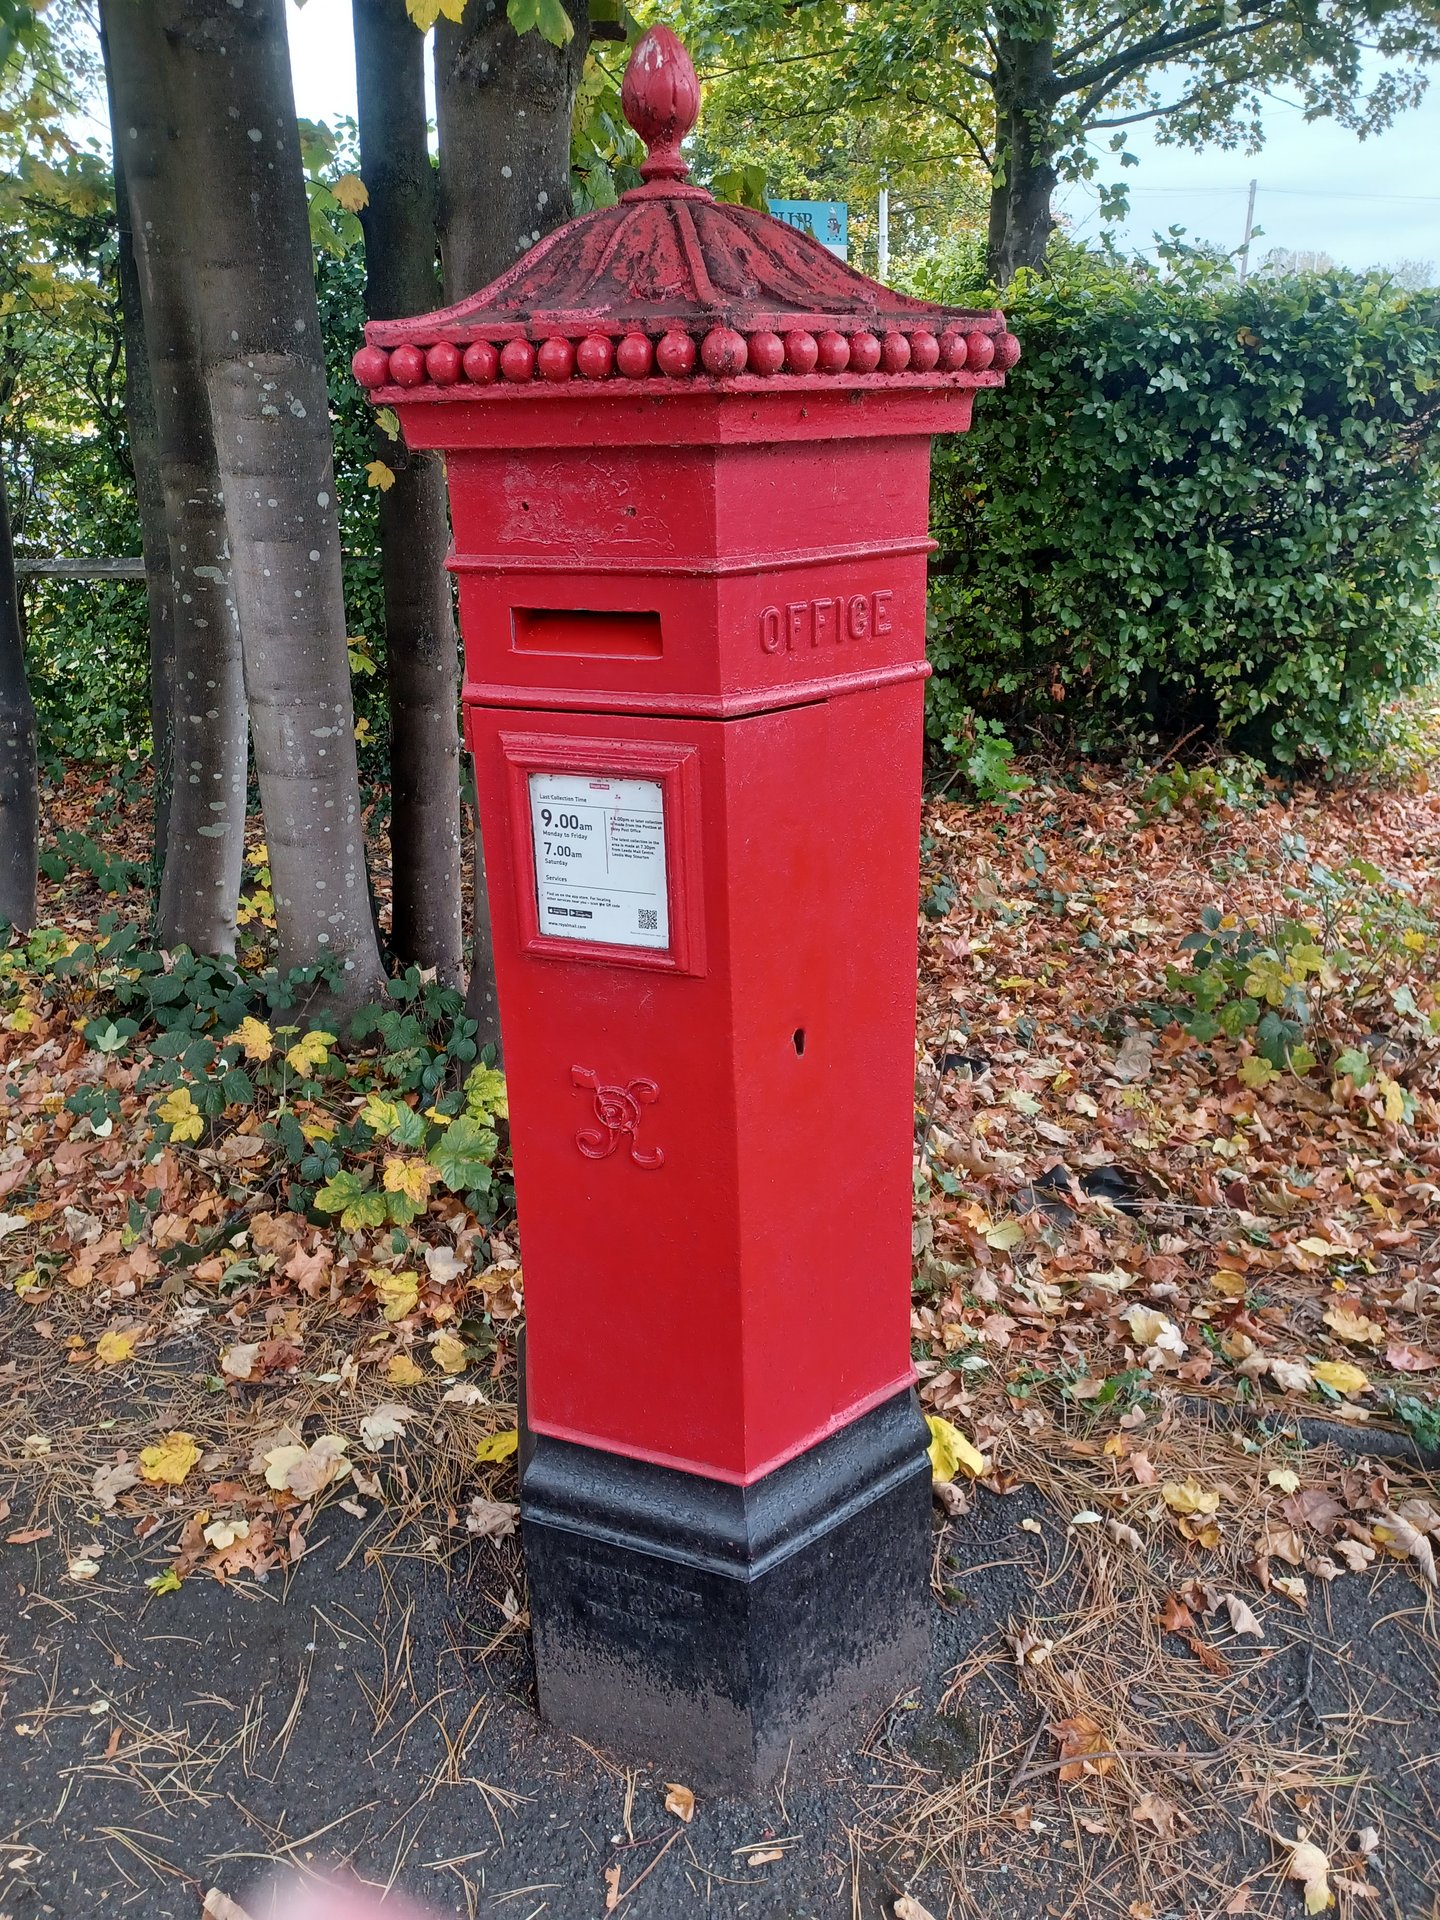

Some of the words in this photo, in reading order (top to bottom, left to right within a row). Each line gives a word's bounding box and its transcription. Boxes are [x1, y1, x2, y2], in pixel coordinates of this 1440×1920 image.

[771, 211, 813, 232] UB
[759, 589, 893, 655] OFFICE
[540, 808, 592, 831] 9.00am
[542, 830, 563, 838] Monday
[544, 842, 582, 858] 7.00am
[545, 858, 568, 866] Saturday
